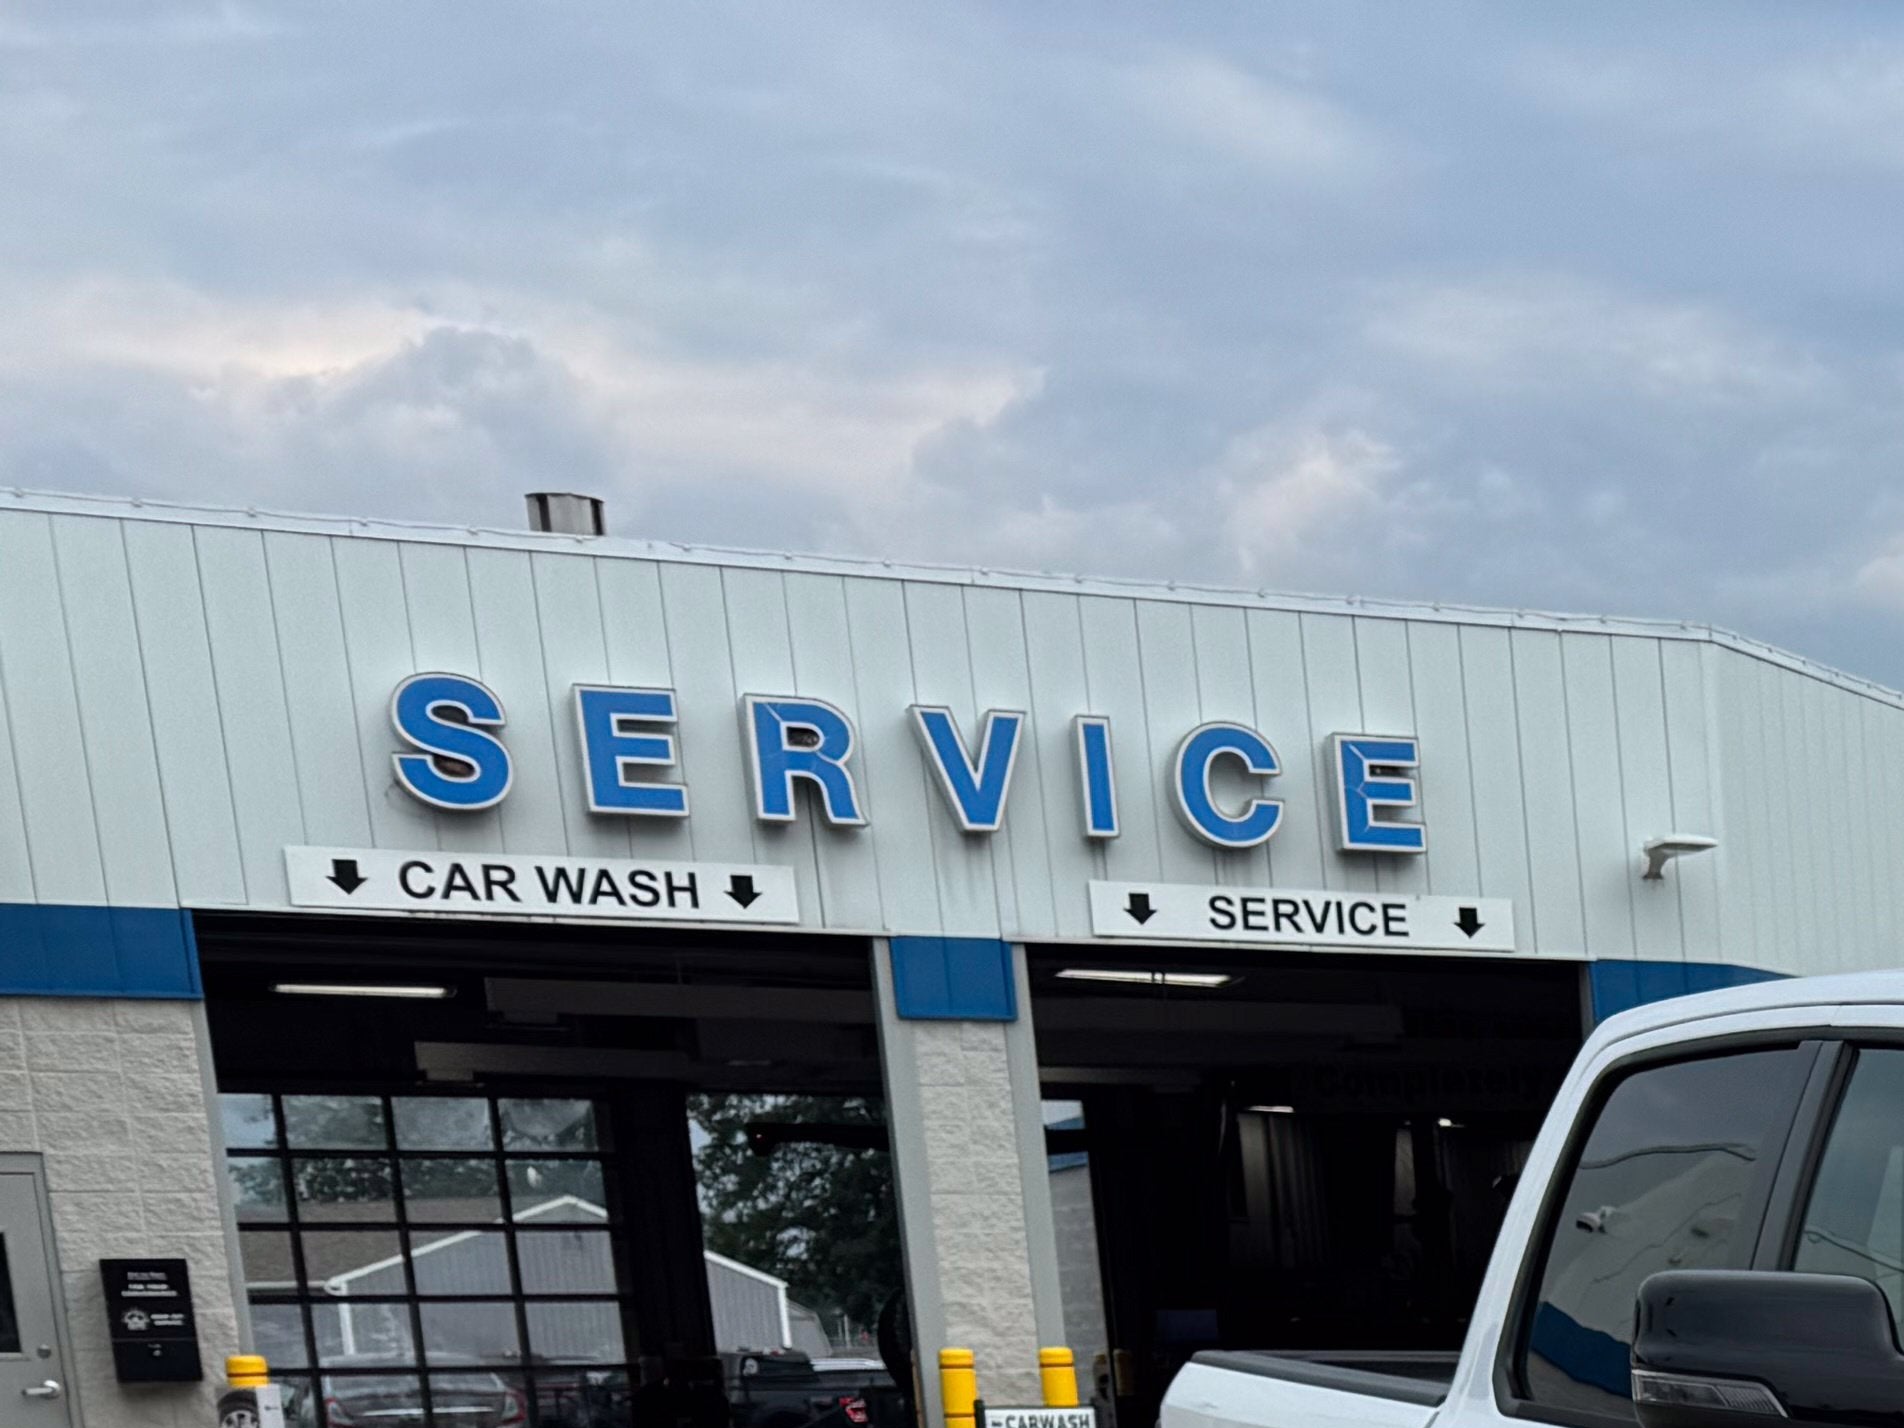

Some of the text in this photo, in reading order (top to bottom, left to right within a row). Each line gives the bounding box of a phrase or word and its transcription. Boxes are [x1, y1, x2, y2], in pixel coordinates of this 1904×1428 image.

[390, 671, 1428, 854] SERVICE
[399, 860, 700, 908] CAR WASH
[1208, 895, 1410, 937] SERVICE
